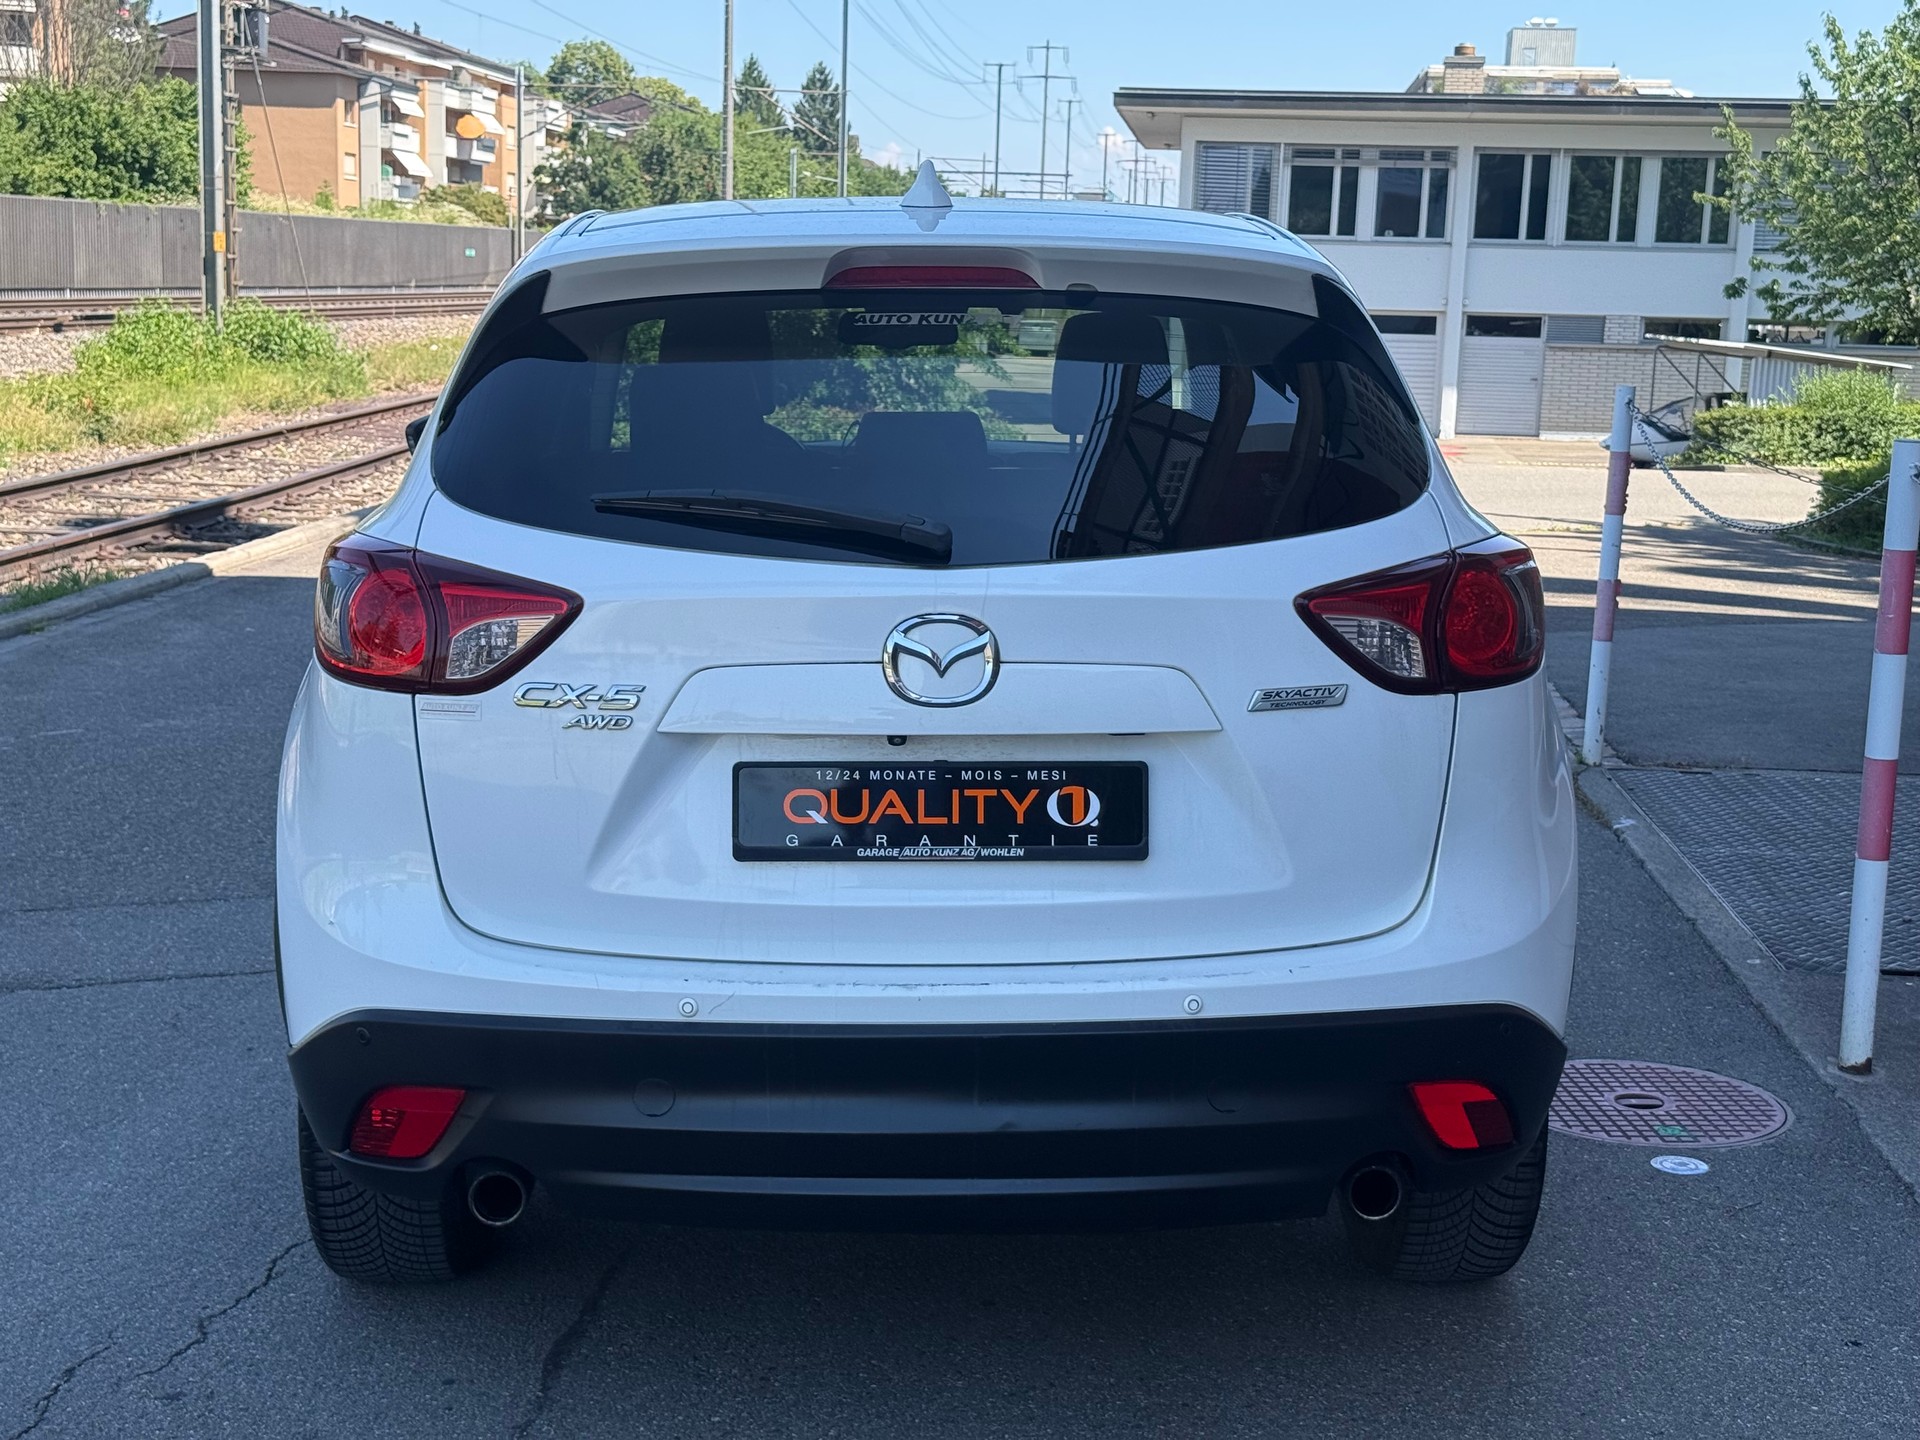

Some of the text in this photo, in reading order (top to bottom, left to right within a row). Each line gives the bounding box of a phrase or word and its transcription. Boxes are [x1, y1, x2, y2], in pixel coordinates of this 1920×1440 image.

[855, 314, 913, 324] AUTO
[513, 681, 647, 711] CX-5
[1261, 687, 1339, 700] SKYACTIV
[1270, 699, 1327, 708] TECHNOLOGY
[562, 714, 633, 730] AWD
[816, 770, 861, 781] 12/24
[869, 770, 937, 781] MONATE
[961, 770, 1003, 781] MOIS
[1027, 770, 1067, 781] MESI
[783, 788, 1040, 824] QUALITY
[786, 833, 1099, 847] GARANTIE
[857, 848, 1025, 857] GARAGE AUTO KUNZ AG WOHLEN
